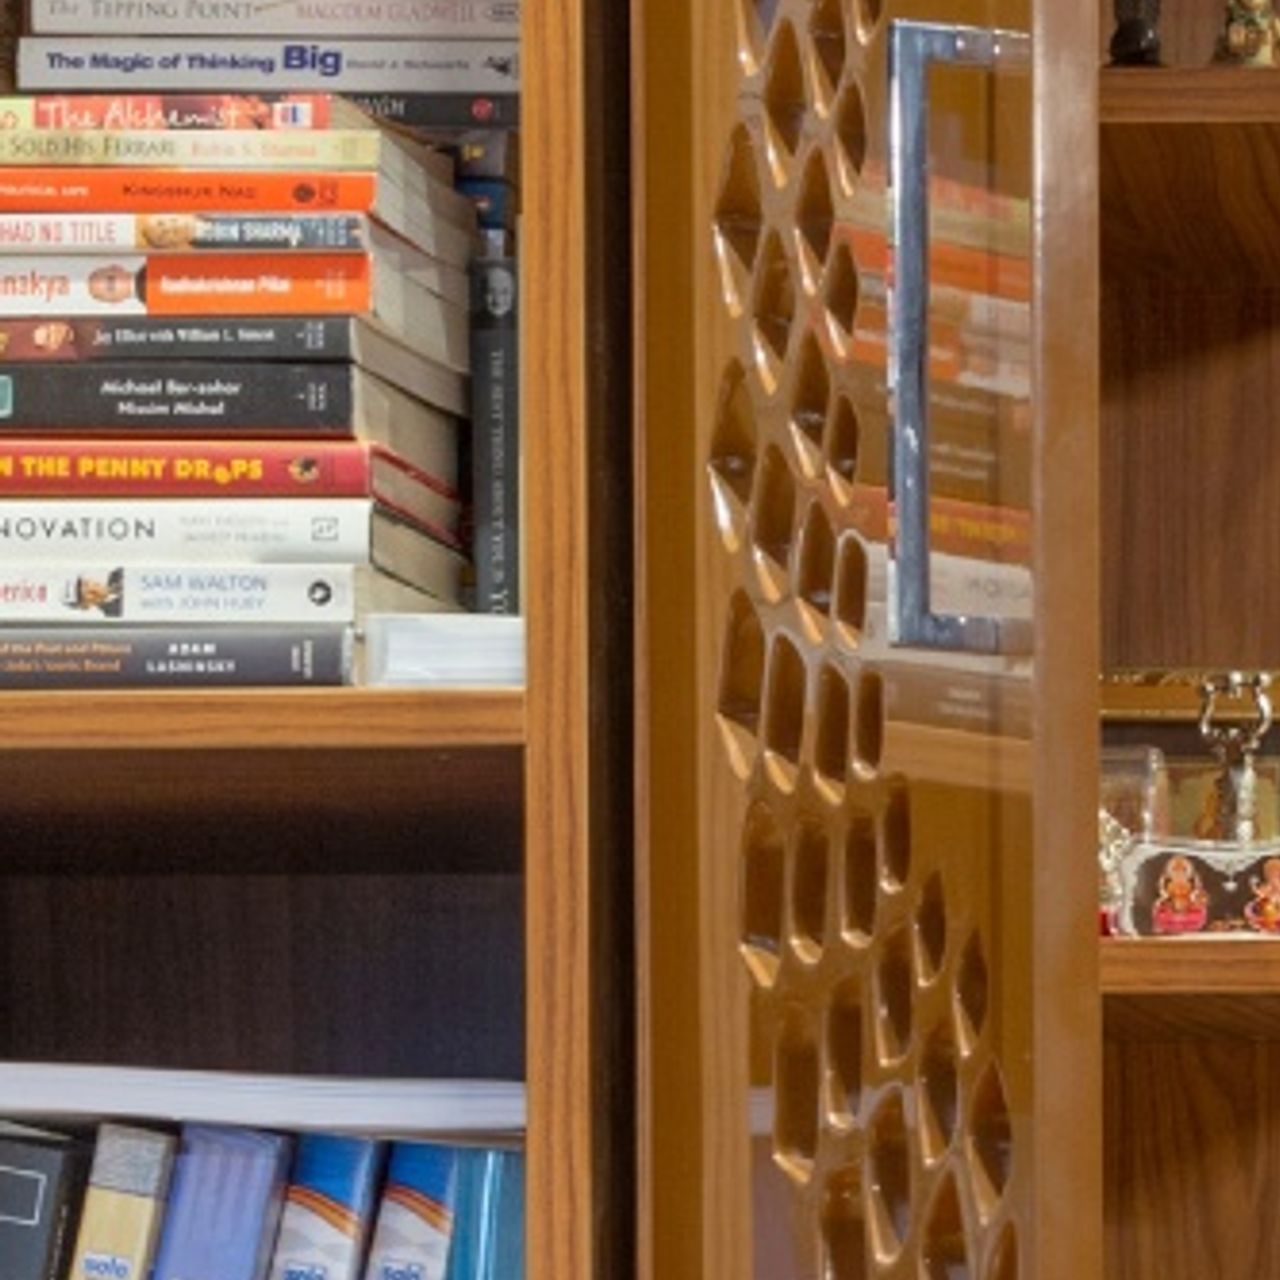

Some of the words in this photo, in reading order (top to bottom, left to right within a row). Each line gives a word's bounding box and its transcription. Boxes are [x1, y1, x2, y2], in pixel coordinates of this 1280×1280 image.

[184, 0, 253, 20] POINT
[46, 52, 85, 69] The
[89, 52, 154, 73] Magic
[157, 52, 182, 69] of
[186, 52, 276, 74] Thinking
[283, 45, 343, 77] Big
[103, 95, 243, 130] Alchemist
[70, 220, 117, 243] TITLE
[20, 455, 71, 477] THE
[77, 456, 167, 479] PENNY
[186, 574, 268, 592] WALTON
[83, 1252, 130, 1279] solo
